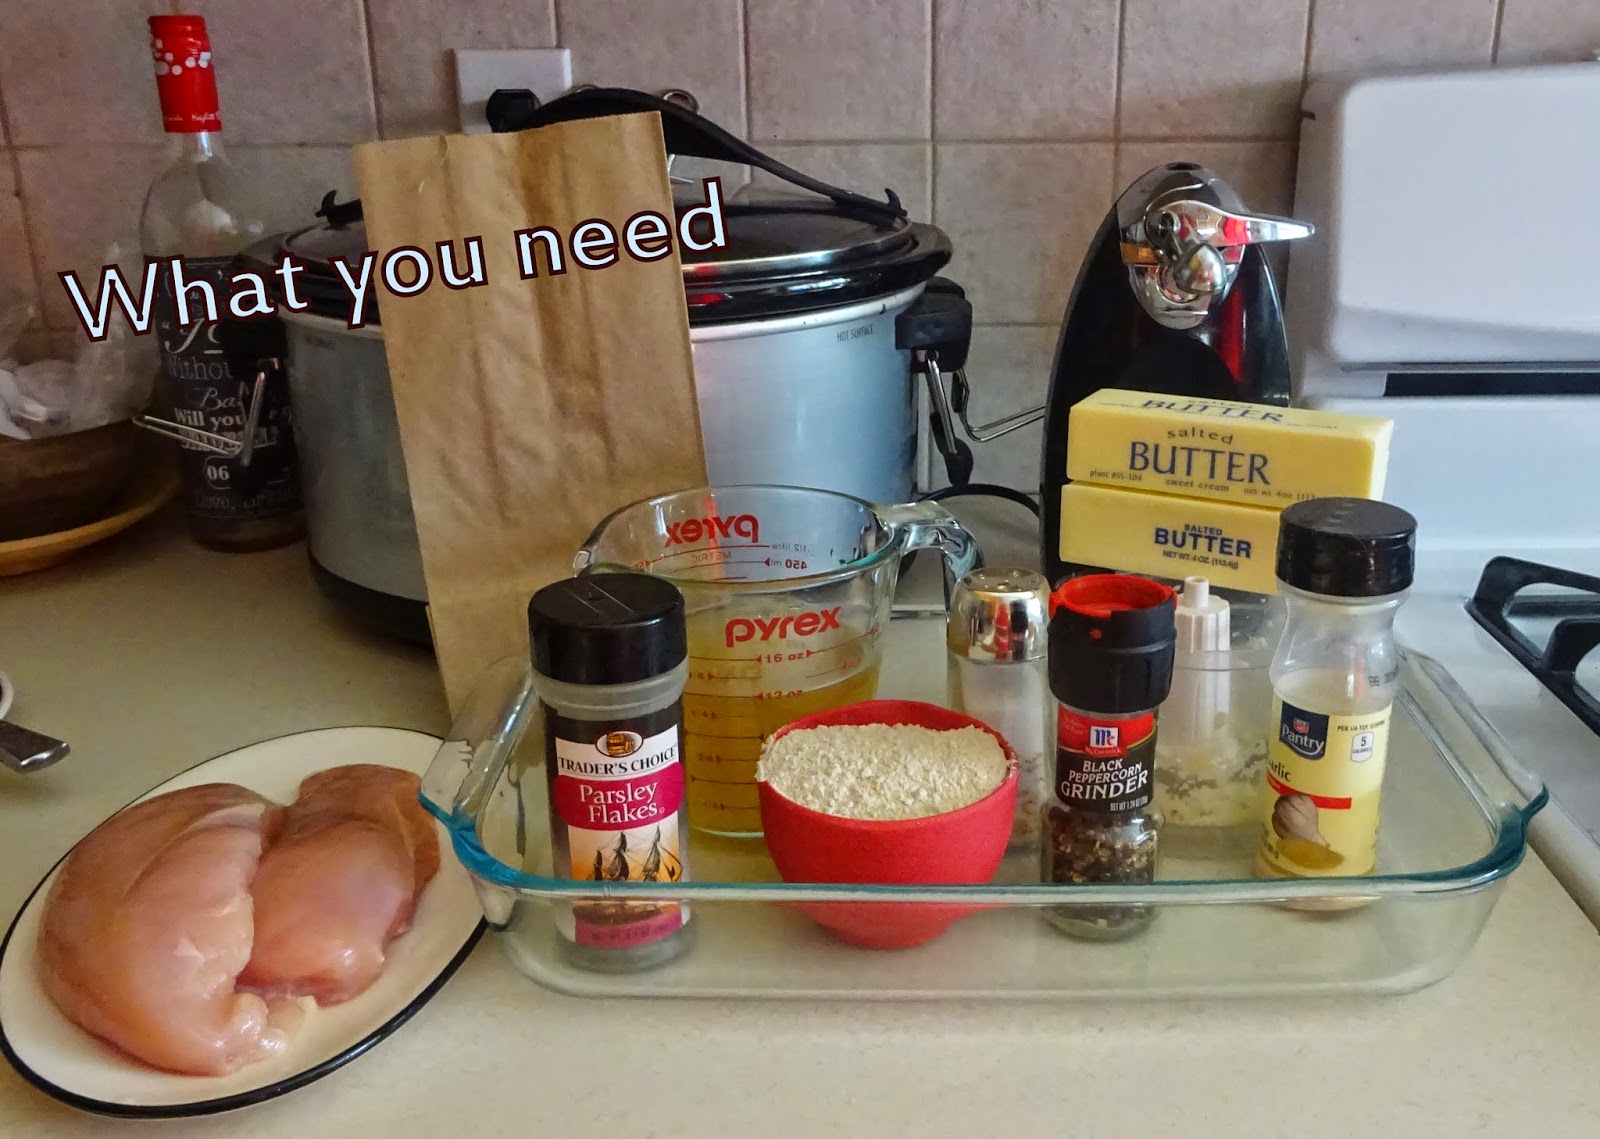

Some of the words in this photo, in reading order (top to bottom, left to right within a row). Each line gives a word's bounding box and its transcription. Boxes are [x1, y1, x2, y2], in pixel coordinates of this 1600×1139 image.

[837, 330, 849, 342] HOT
[174, 407, 205, 427] Will
[1142, 400, 1285, 422] BUTTER
[1167, 427, 1234, 444] salted
[207, 464, 231, 481] 06
[1129, 441, 1271, 485] BUTTER
[1166, 478, 1194, 488] sweet
[1199, 482, 1230, 492] cream
[1184, 523, 1223, 536] SALTED
[1154, 527, 1252, 558] BUTTER
[1163, 550, 1178, 558] NET
[724, 606, 841, 648] pyrex
[765, 653, 783, 664] 16
[787, 651, 805, 662] oz
[766, 690, 785, 700] 12
[1281, 723, 1325, 750] Pantry
[1360, 736, 1367, 747] 5
[558, 756, 628, 775] TRADER'S
[630, 746, 677, 772] CHOICE
[1082, 759, 1123, 772] BLACK
[1069, 762, 1142, 784] PEPPERCORN
[579, 782, 658, 804] Parsley
[1060, 769, 1148, 800] GRINDER
[588, 802, 658, 824] Flakes
